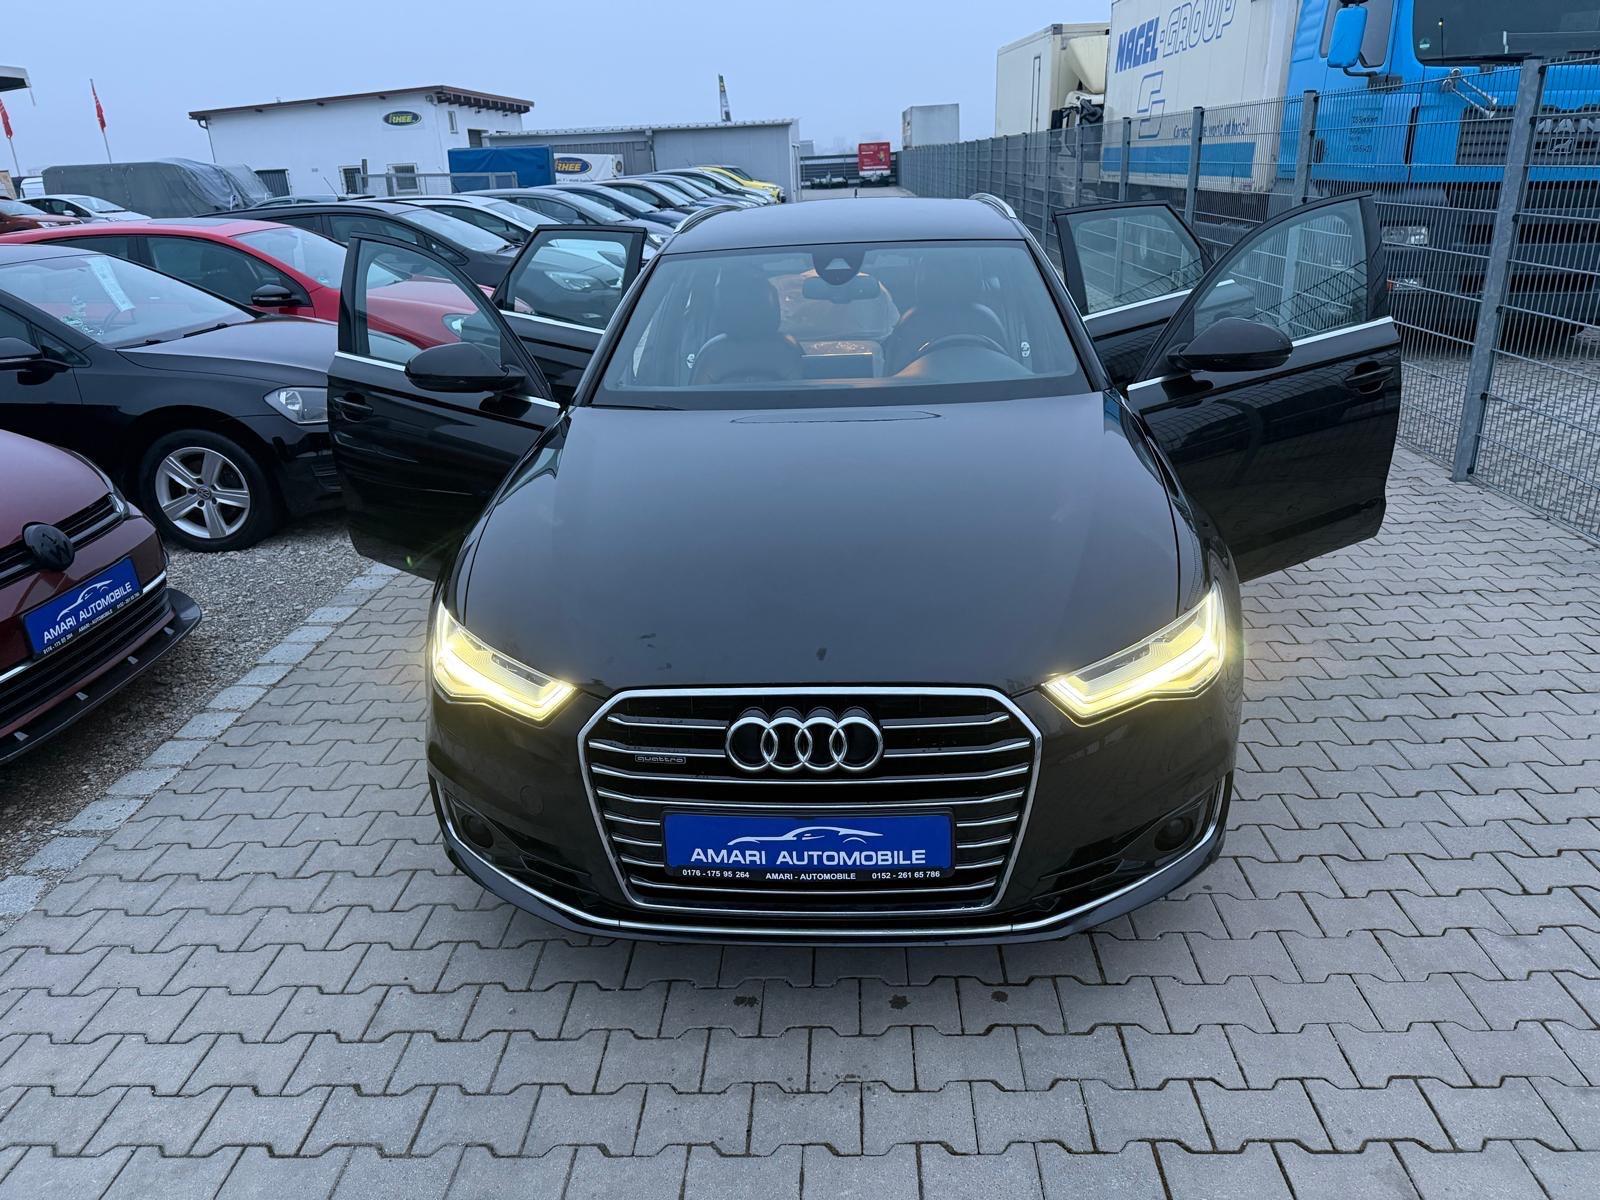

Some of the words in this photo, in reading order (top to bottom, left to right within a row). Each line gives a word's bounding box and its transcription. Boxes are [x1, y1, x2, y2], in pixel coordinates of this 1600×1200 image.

[555, 162, 582, 172] RHEE
[43, 616, 77, 644] AMARI
[79, 581, 133, 622] AUTOMOBILE
[690, 848, 766, 865] AMARI
[776, 849, 926, 866] AUTOMOBILE
[682, 869, 701, 877] 0176
[722, 870, 733, 878] 95
[765, 872, 793, 880] AMARI
[800, 872, 856, 880] AUTOMOBILE
[897, 871, 912, 879] 261
[926, 870, 940, 878] 786
